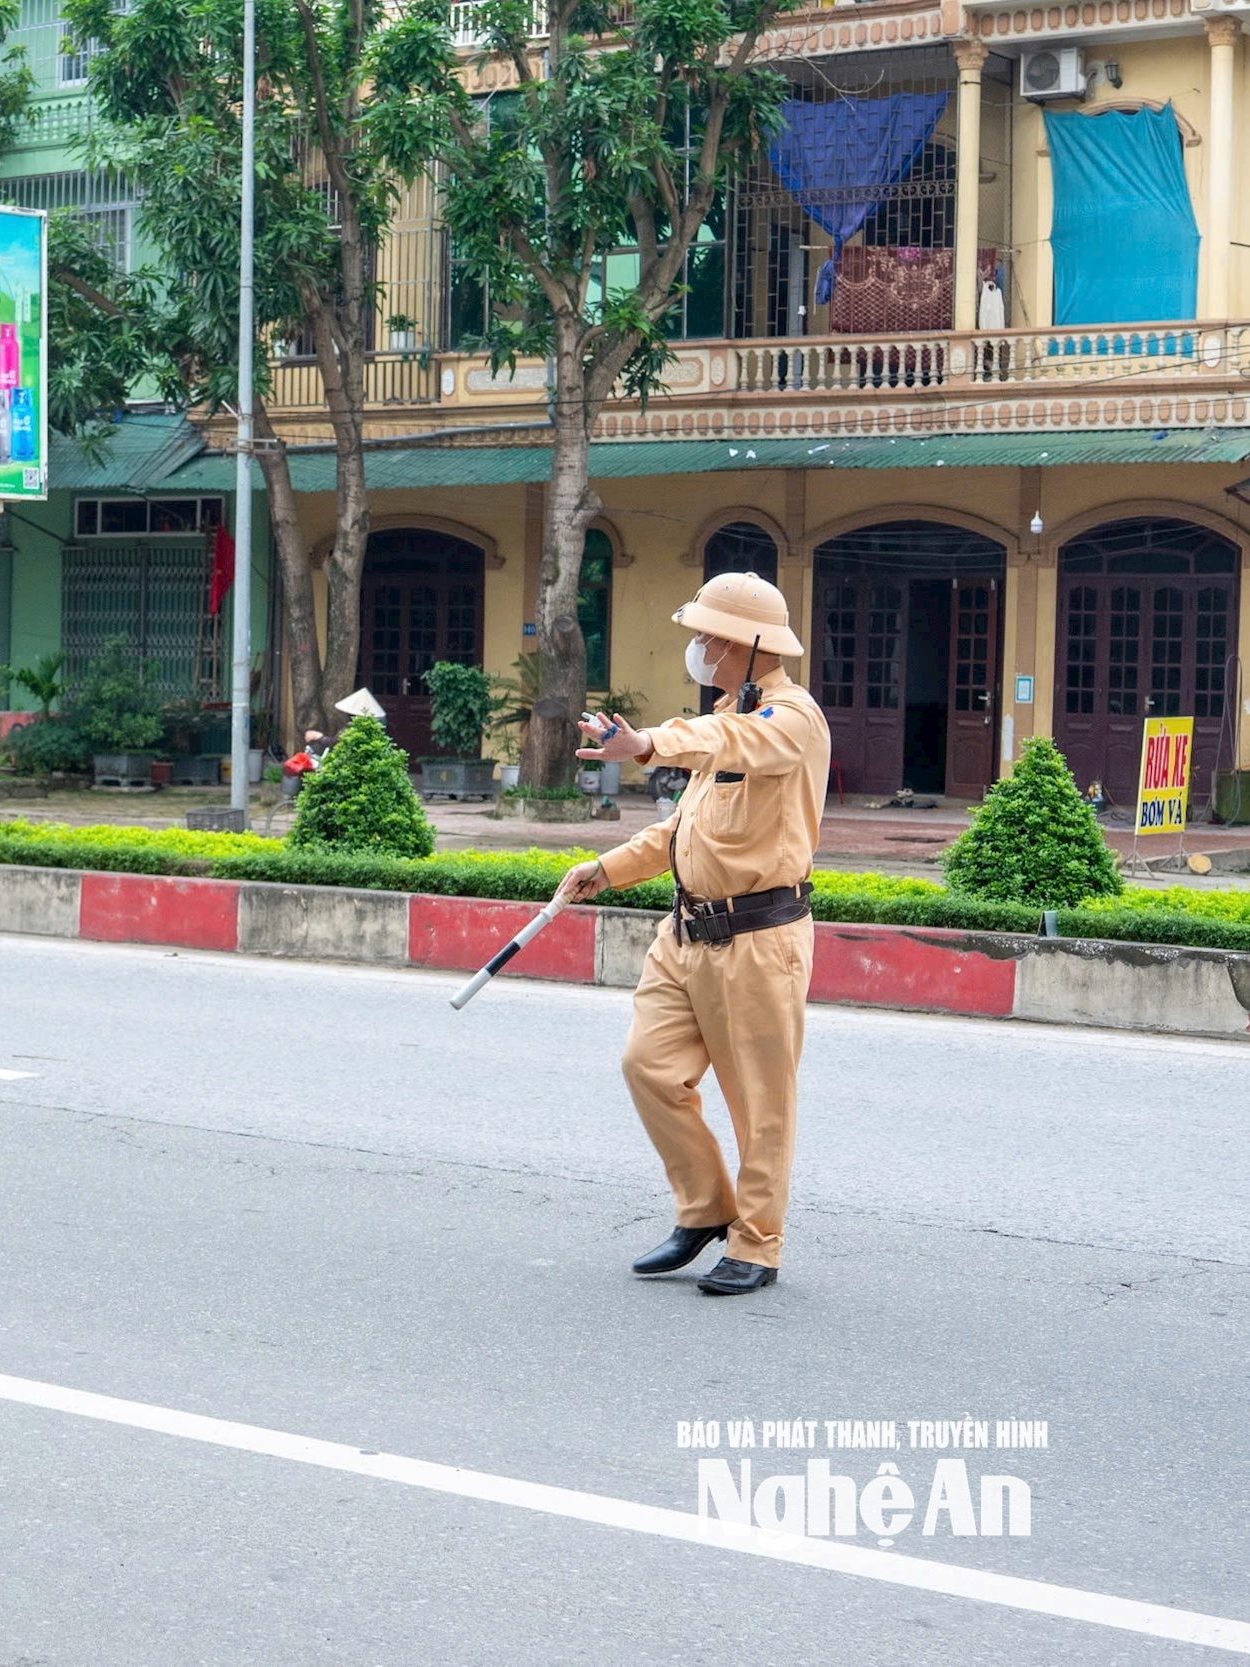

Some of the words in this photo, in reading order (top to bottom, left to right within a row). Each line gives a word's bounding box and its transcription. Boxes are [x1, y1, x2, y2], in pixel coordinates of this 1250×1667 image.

[1144, 722, 1171, 789] RỬA
[1172, 734, 1188, 788] XE
[1141, 796, 1165, 827] BƠM
[1168, 791, 1182, 825] VÁ
